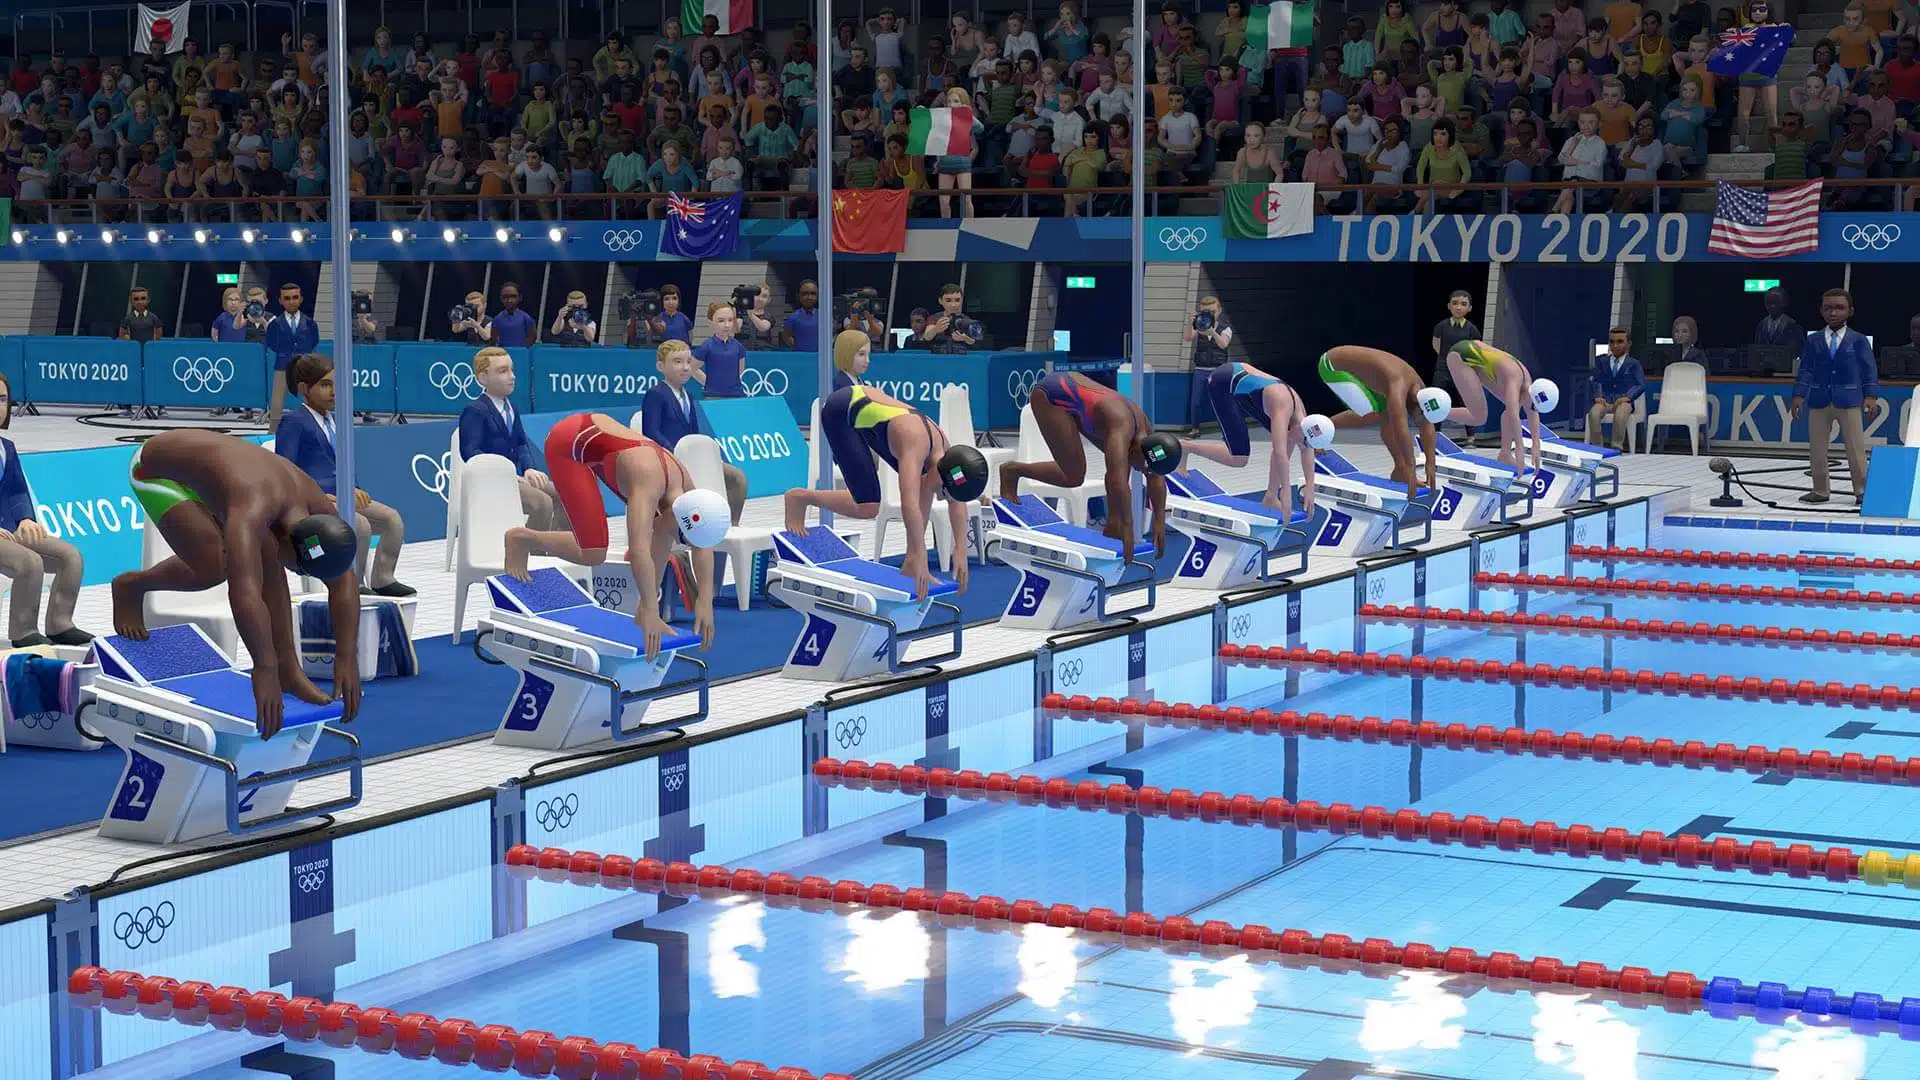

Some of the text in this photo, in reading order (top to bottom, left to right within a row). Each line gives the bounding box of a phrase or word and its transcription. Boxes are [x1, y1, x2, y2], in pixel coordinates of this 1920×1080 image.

[1332, 213, 1688, 262] TOKYO 2020
[38, 362, 128, 381] TOKYO 2020
[352, 369, 380, 388] 020
[549, 373, 609, 393] TOKYO
[742, 431, 791, 460] 2020
[1534, 478, 1546, 494] 9
[1440, 498, 1451, 515] 8
[36, 498, 121, 538] OKYO
[680, 515, 693, 530] JPN
[1331, 523, 1343, 540] 7
[1373, 520, 1392, 545] 7
[1191, 551, 1204, 570] 6
[1243, 550, 1262, 575] 6
[604, 577, 628, 589] 2020
[1022, 587, 1036, 608] 5
[1080, 586, 1099, 614] 5
[804, 633, 820, 657] 4
[521, 693, 538, 720] 3
[128, 775, 146, 808] 2
[293, 858, 329, 875] TOKYO 2020
